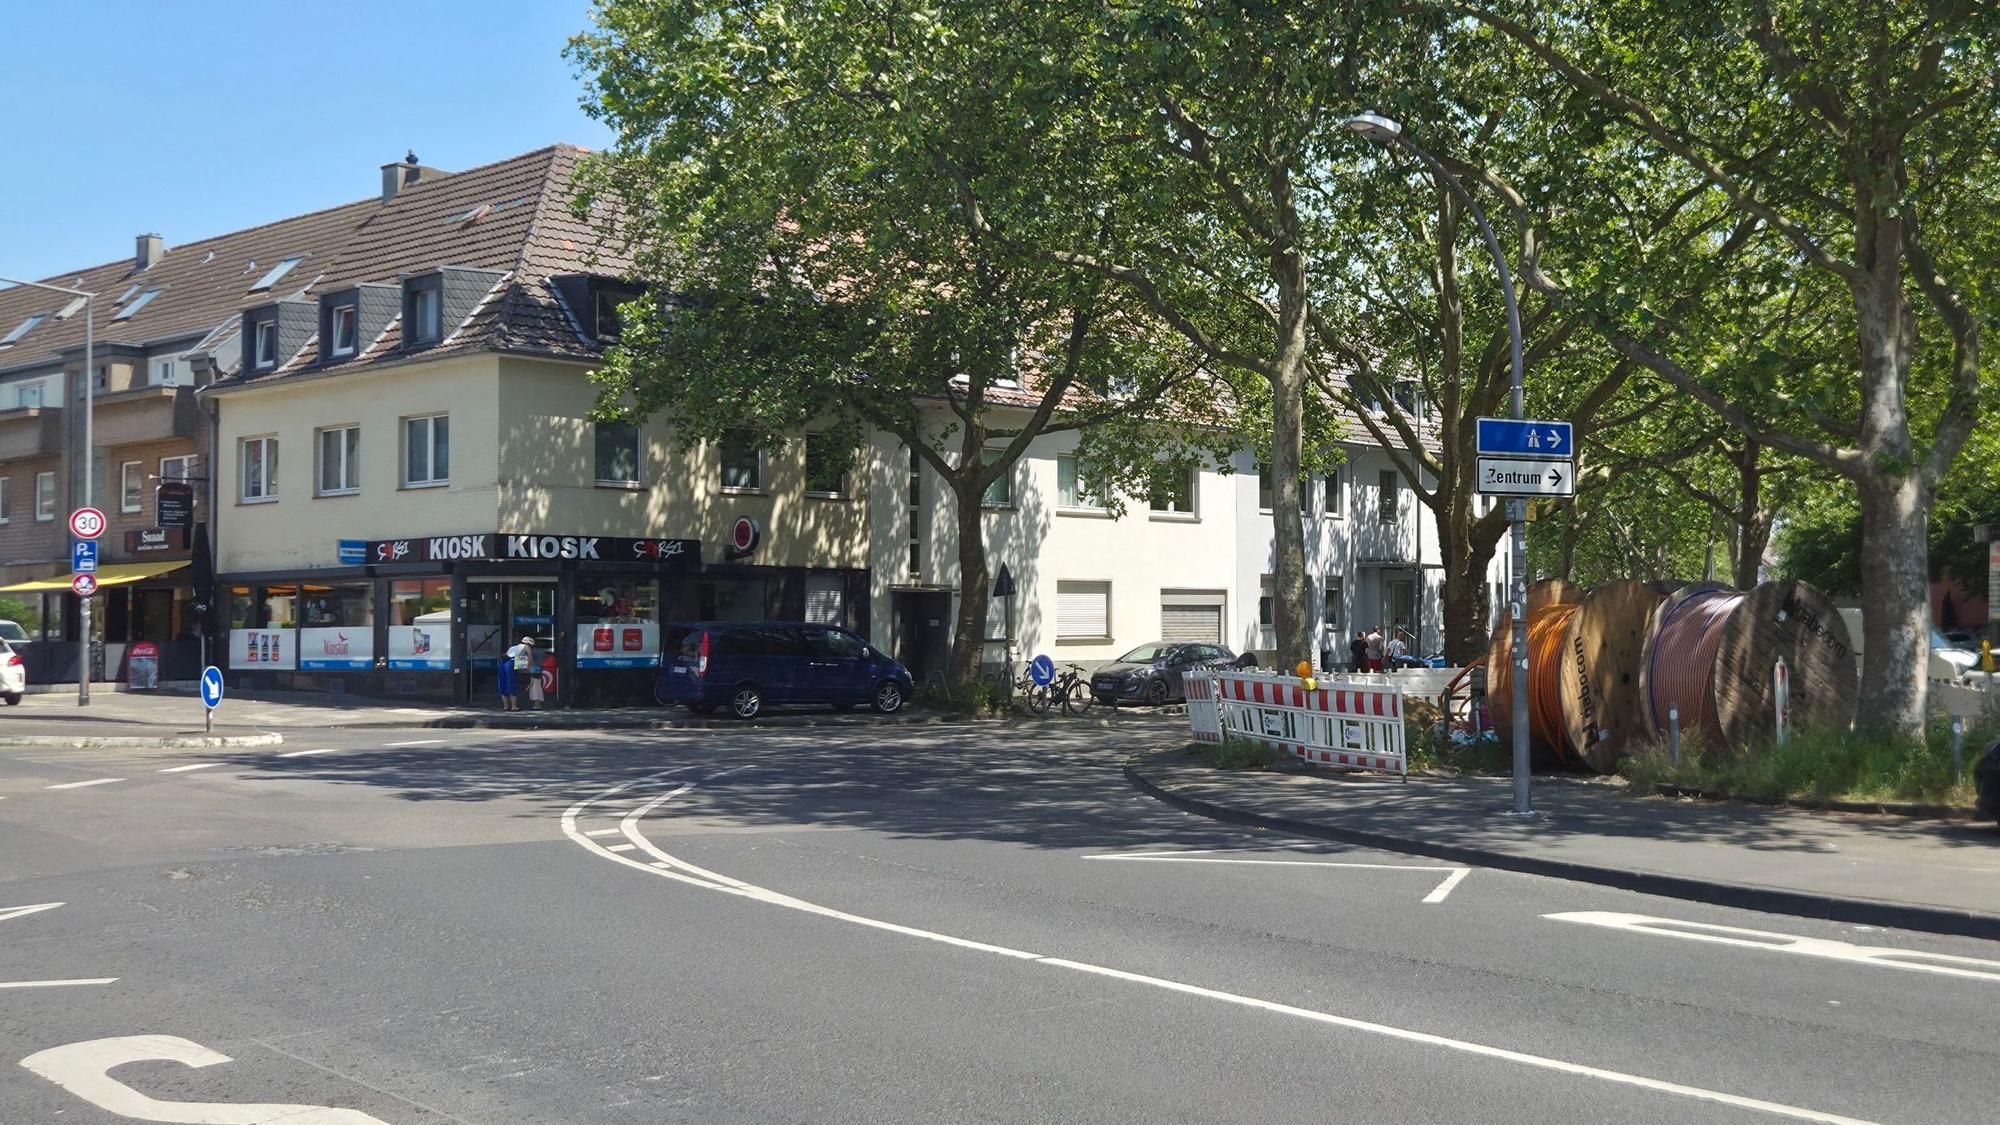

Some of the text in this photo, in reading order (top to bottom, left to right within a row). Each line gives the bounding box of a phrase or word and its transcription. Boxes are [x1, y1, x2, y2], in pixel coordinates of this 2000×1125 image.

[1487, 468, 1541, 484] Zentrum
[78, 517, 98, 530] 30
[429, 536, 486, 560] KIOSK
[507, 535, 600, 560] KIOSK
